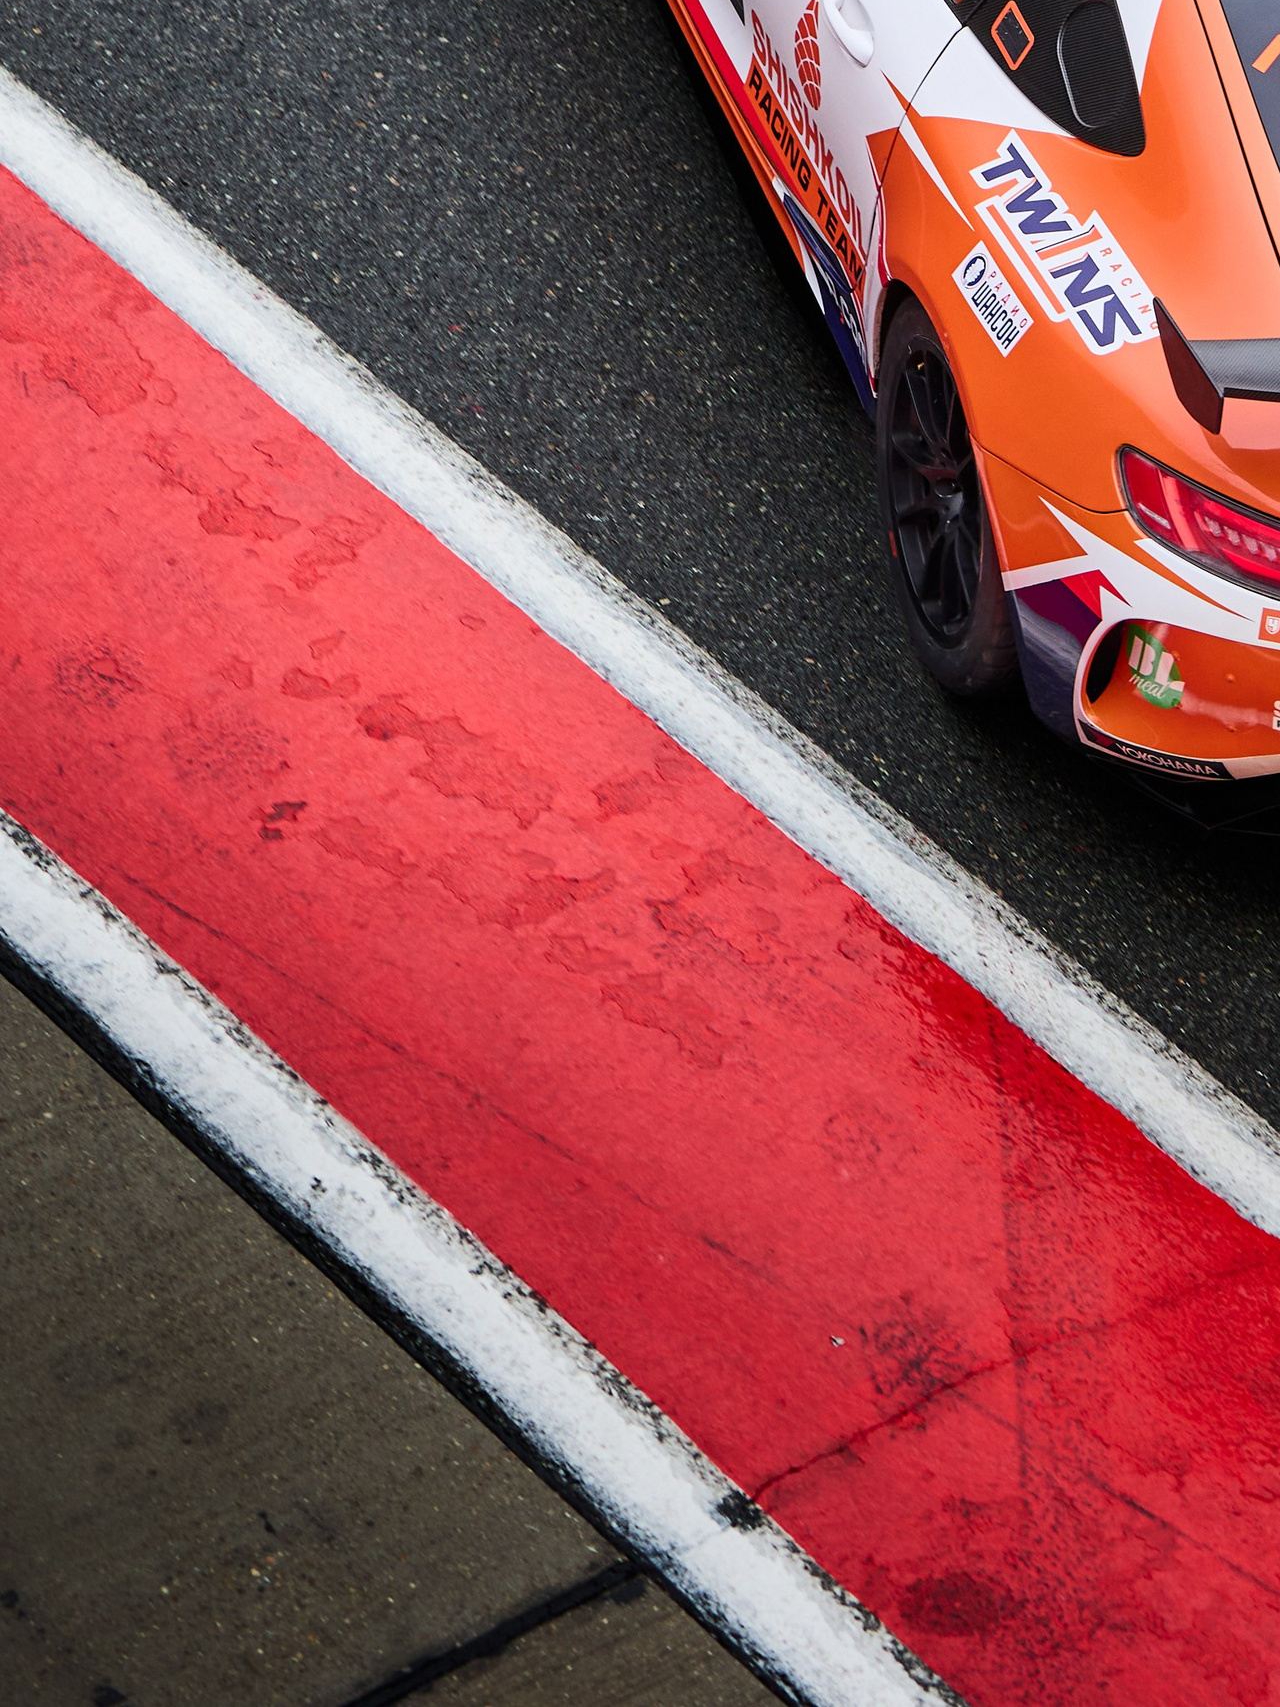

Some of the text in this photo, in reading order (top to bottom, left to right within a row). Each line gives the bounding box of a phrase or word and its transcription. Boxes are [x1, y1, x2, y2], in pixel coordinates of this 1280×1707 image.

[749, 67, 811, 192] RACING
[817, 194, 864, 287] TEAM
[751, 9, 867, 264] SHISHKOIL
[981, 143, 1142, 347] TWINS
[988, 271, 1028, 328] РАДИО
[971, 281, 1020, 350] ШАНСОН
[1115, 742, 1220, 776] YOKOHAMA
